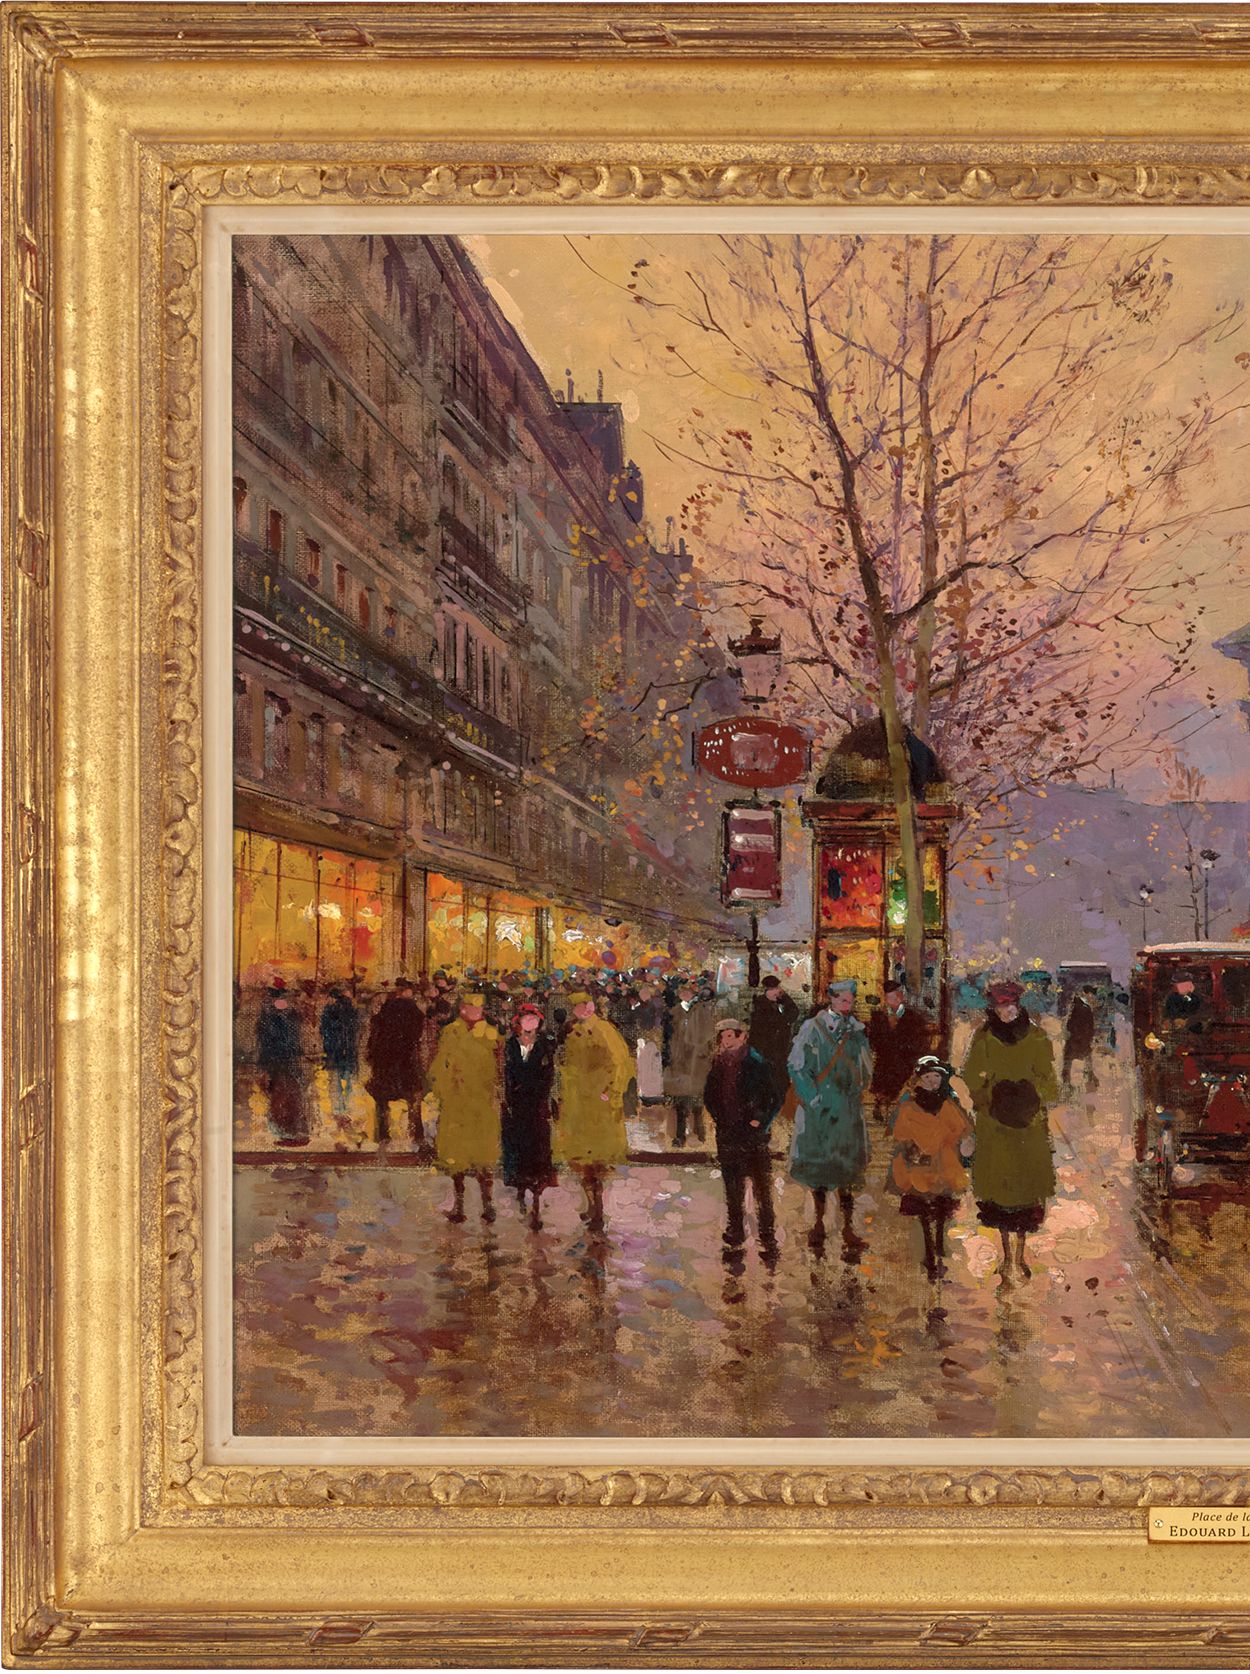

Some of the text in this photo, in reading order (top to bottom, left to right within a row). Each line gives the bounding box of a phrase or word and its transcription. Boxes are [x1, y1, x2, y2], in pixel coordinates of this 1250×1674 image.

[1192, 1511, 1222, 1522] Place
[1225, 1511, 1239, 1522] de
[1169, 1525, 1236, 1538] EDOUARD
